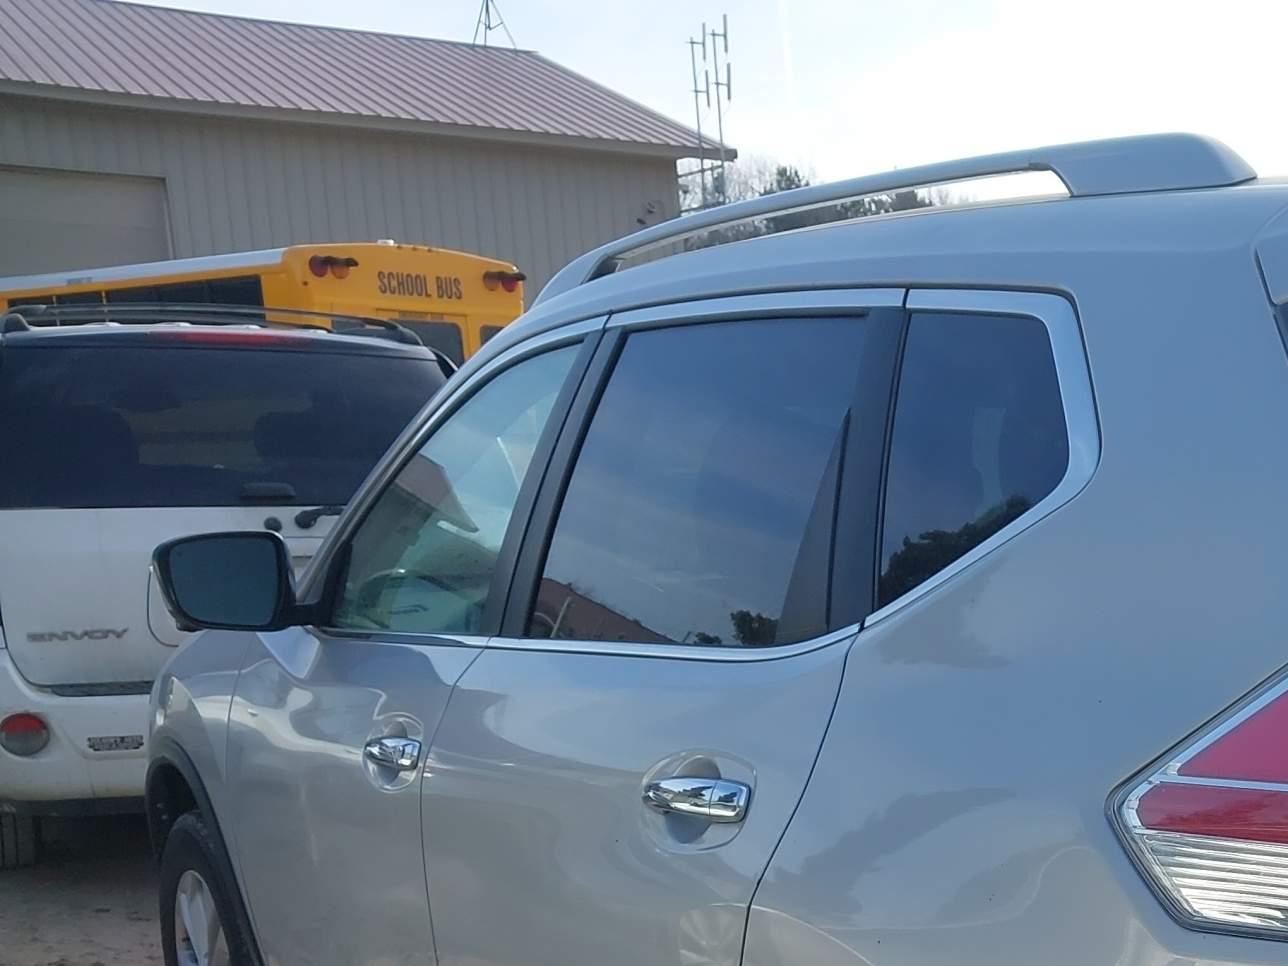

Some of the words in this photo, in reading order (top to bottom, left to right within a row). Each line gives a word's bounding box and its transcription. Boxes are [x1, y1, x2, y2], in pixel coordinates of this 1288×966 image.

[377, 271, 432, 297] SCHOOL
[436, 275, 463, 300] BUS
[27, 628, 129, 642] ENVOY
